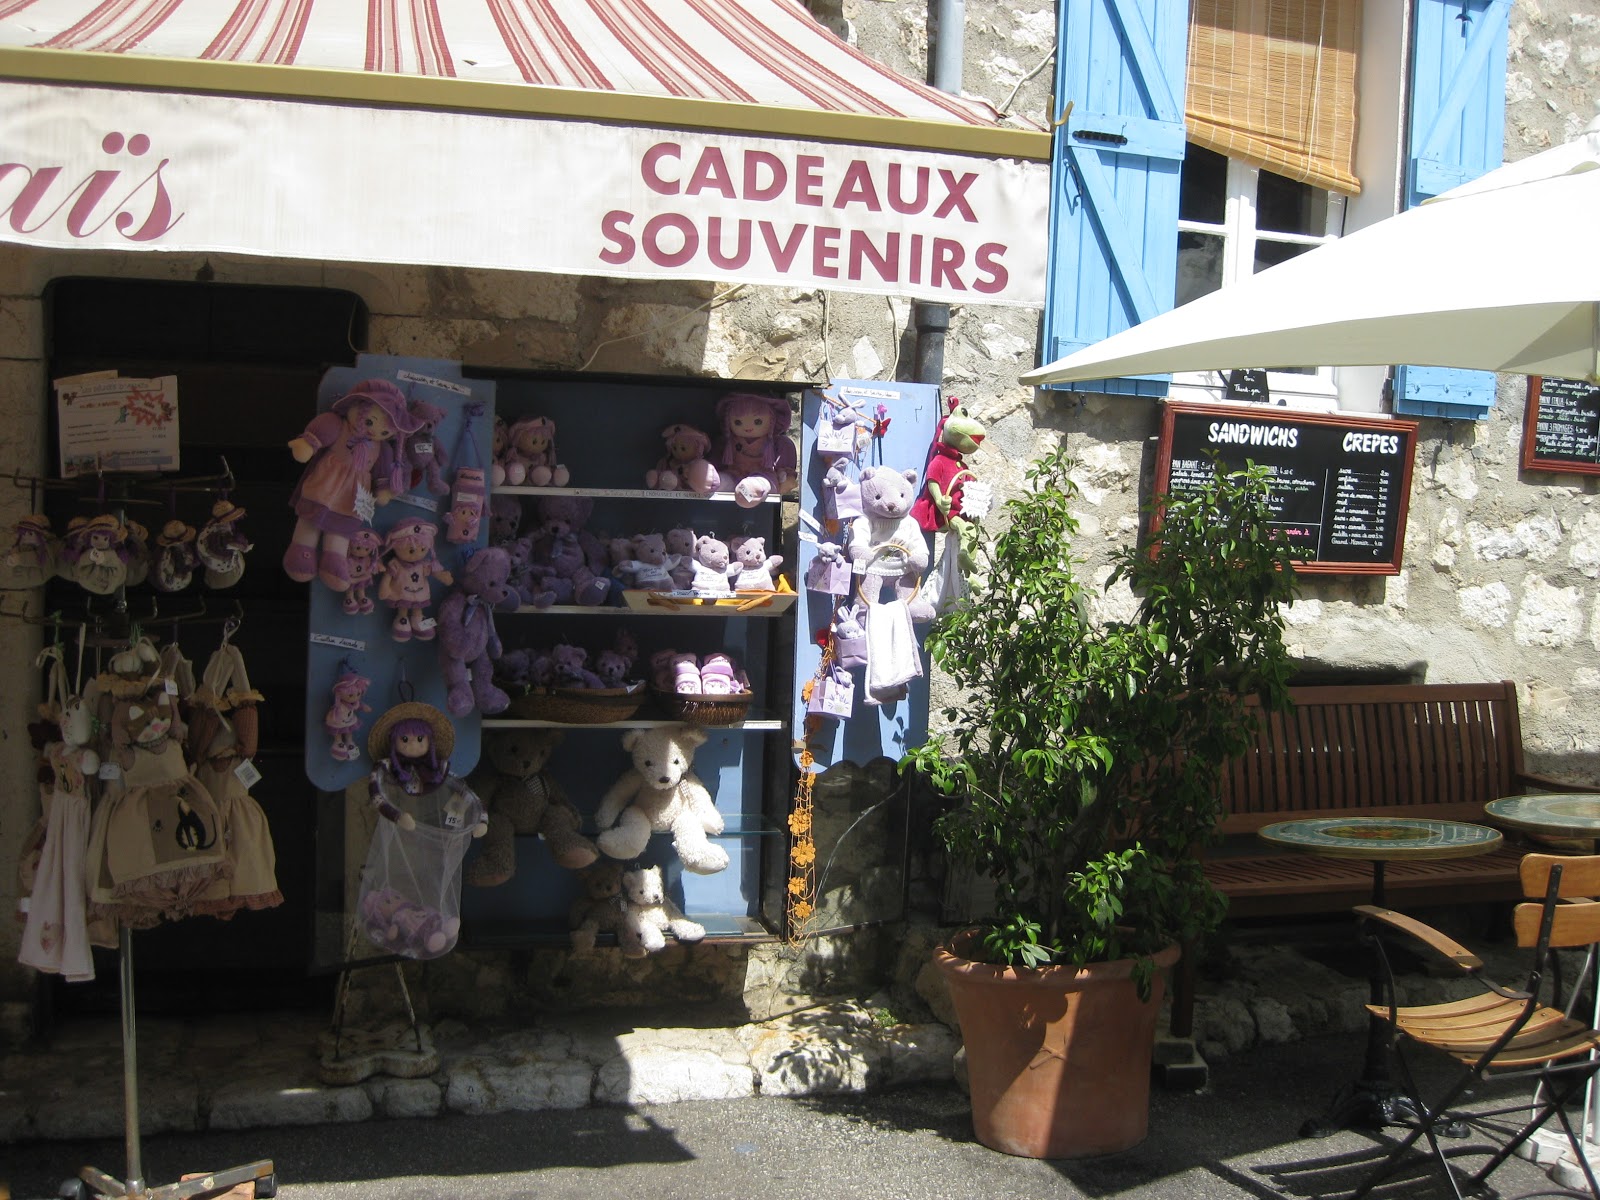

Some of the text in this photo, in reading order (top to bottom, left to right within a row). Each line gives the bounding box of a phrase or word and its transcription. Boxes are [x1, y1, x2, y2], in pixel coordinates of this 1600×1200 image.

[641, 142, 979, 223] CADEAUX
[598, 210, 1009, 294] SOUVENIRS
[1208, 422, 1299, 448] SANDWICHS
[1342, 432, 1399, 455] CREPES
[1172, 460, 1181, 468] PAN
[1331, 537, 1348, 545] Grand
